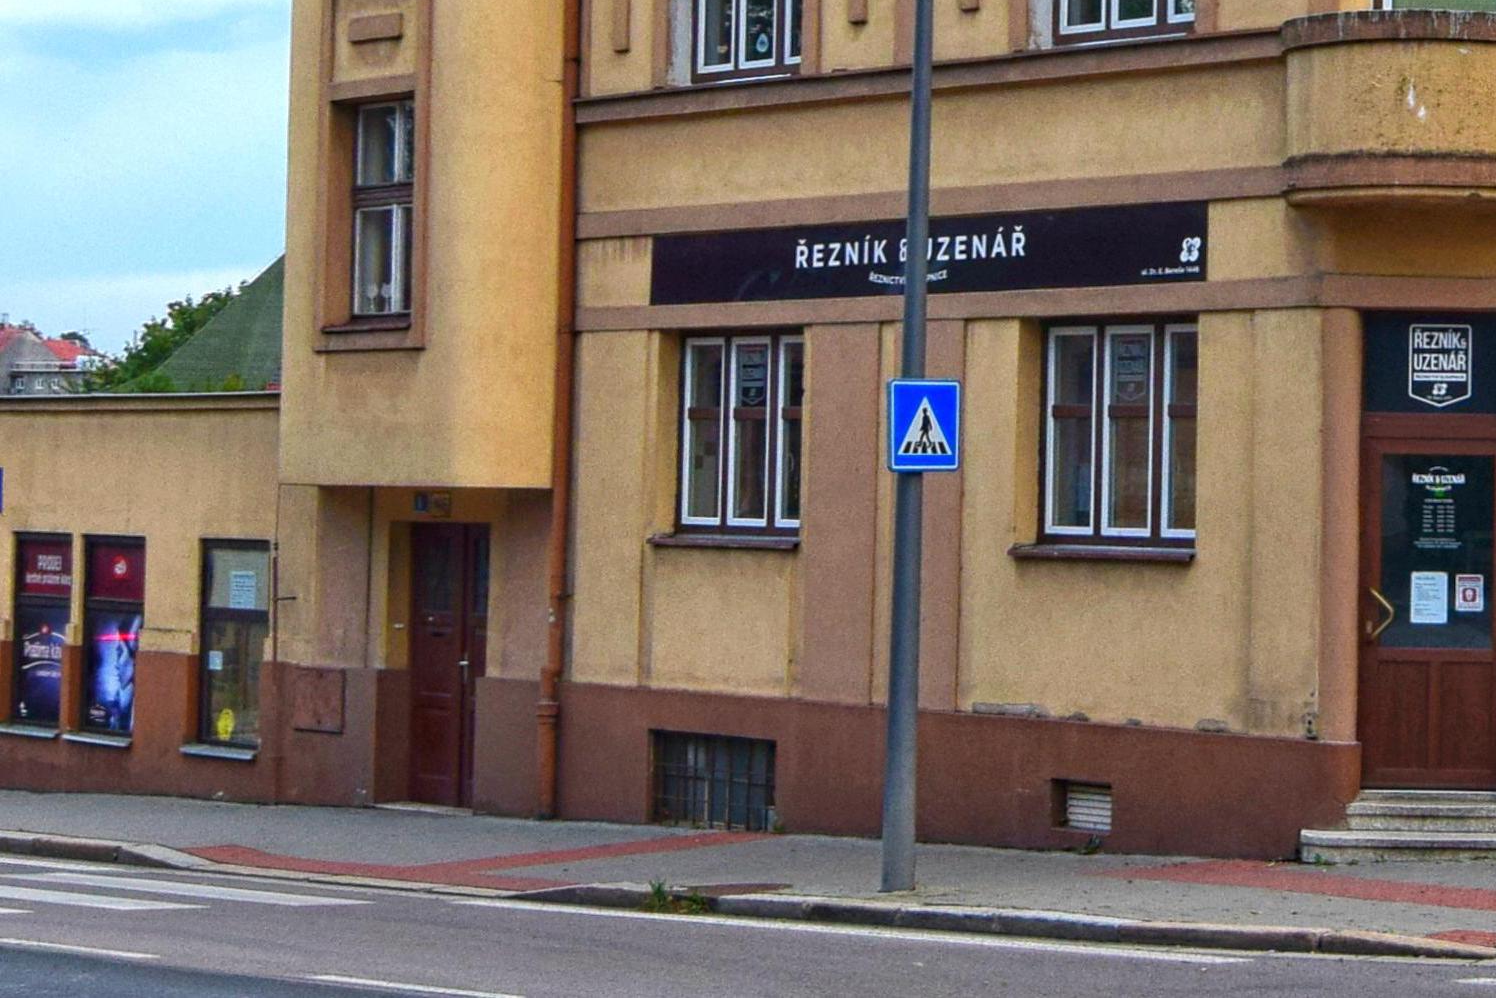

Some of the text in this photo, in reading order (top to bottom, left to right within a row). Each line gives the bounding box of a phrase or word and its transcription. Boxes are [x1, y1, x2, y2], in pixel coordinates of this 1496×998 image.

[795, 235, 888, 269] ŘEZNÍK
[1413, 329, 1460, 349] ŘEZNÍK
[1413, 351, 1467, 371] UZENÁŘ
